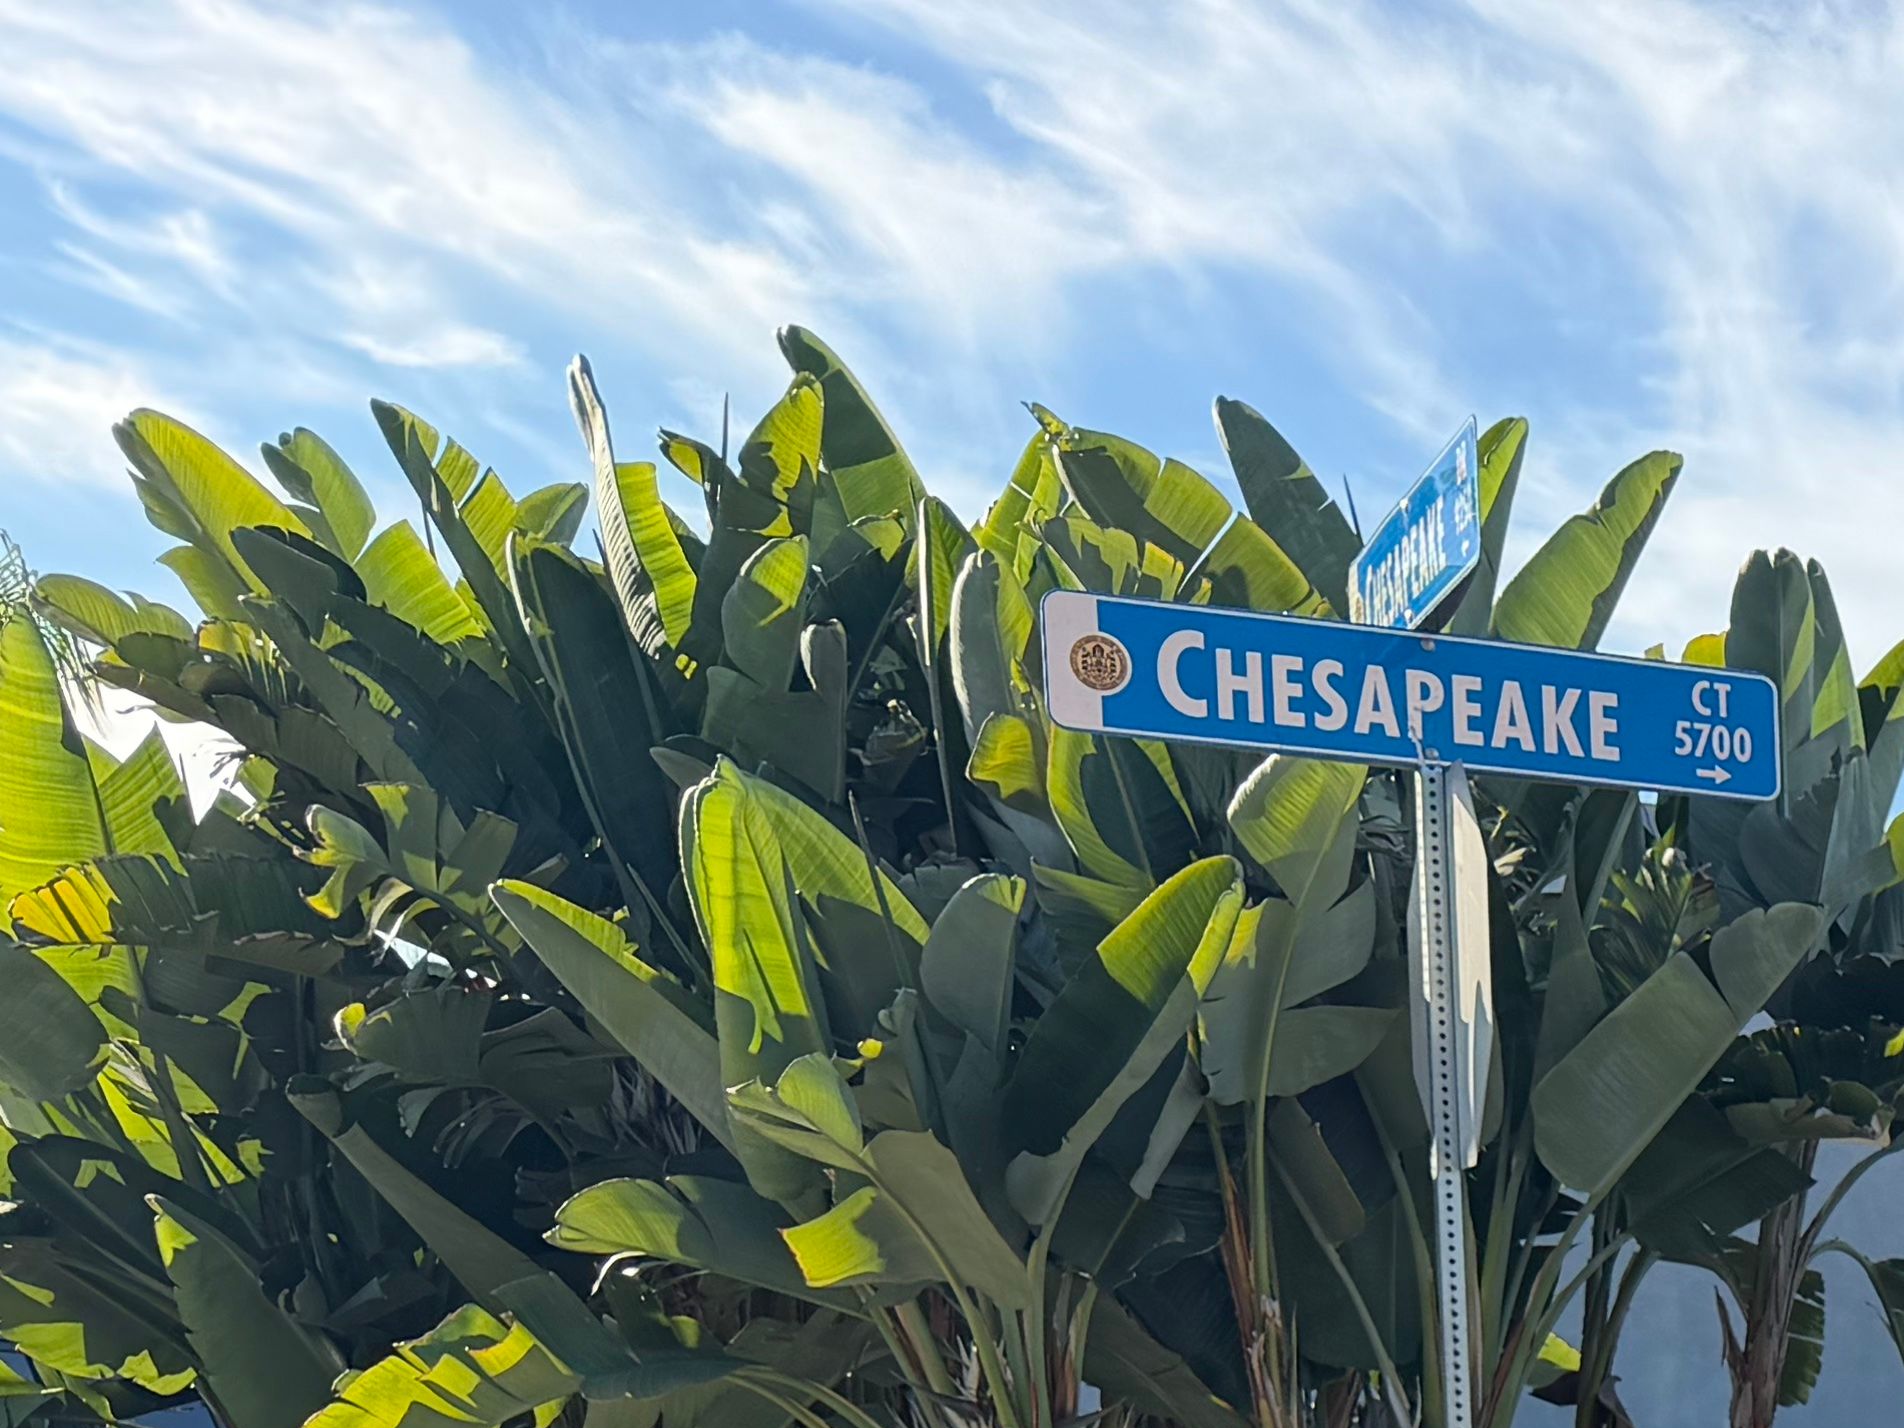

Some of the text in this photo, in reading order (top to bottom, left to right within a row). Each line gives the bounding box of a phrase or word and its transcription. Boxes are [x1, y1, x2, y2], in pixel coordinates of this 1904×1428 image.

[1156, 629, 1621, 762] CHESAPEAKE
[1691, 680, 1731, 718] CT
[1674, 720, 1752, 763] 5700
